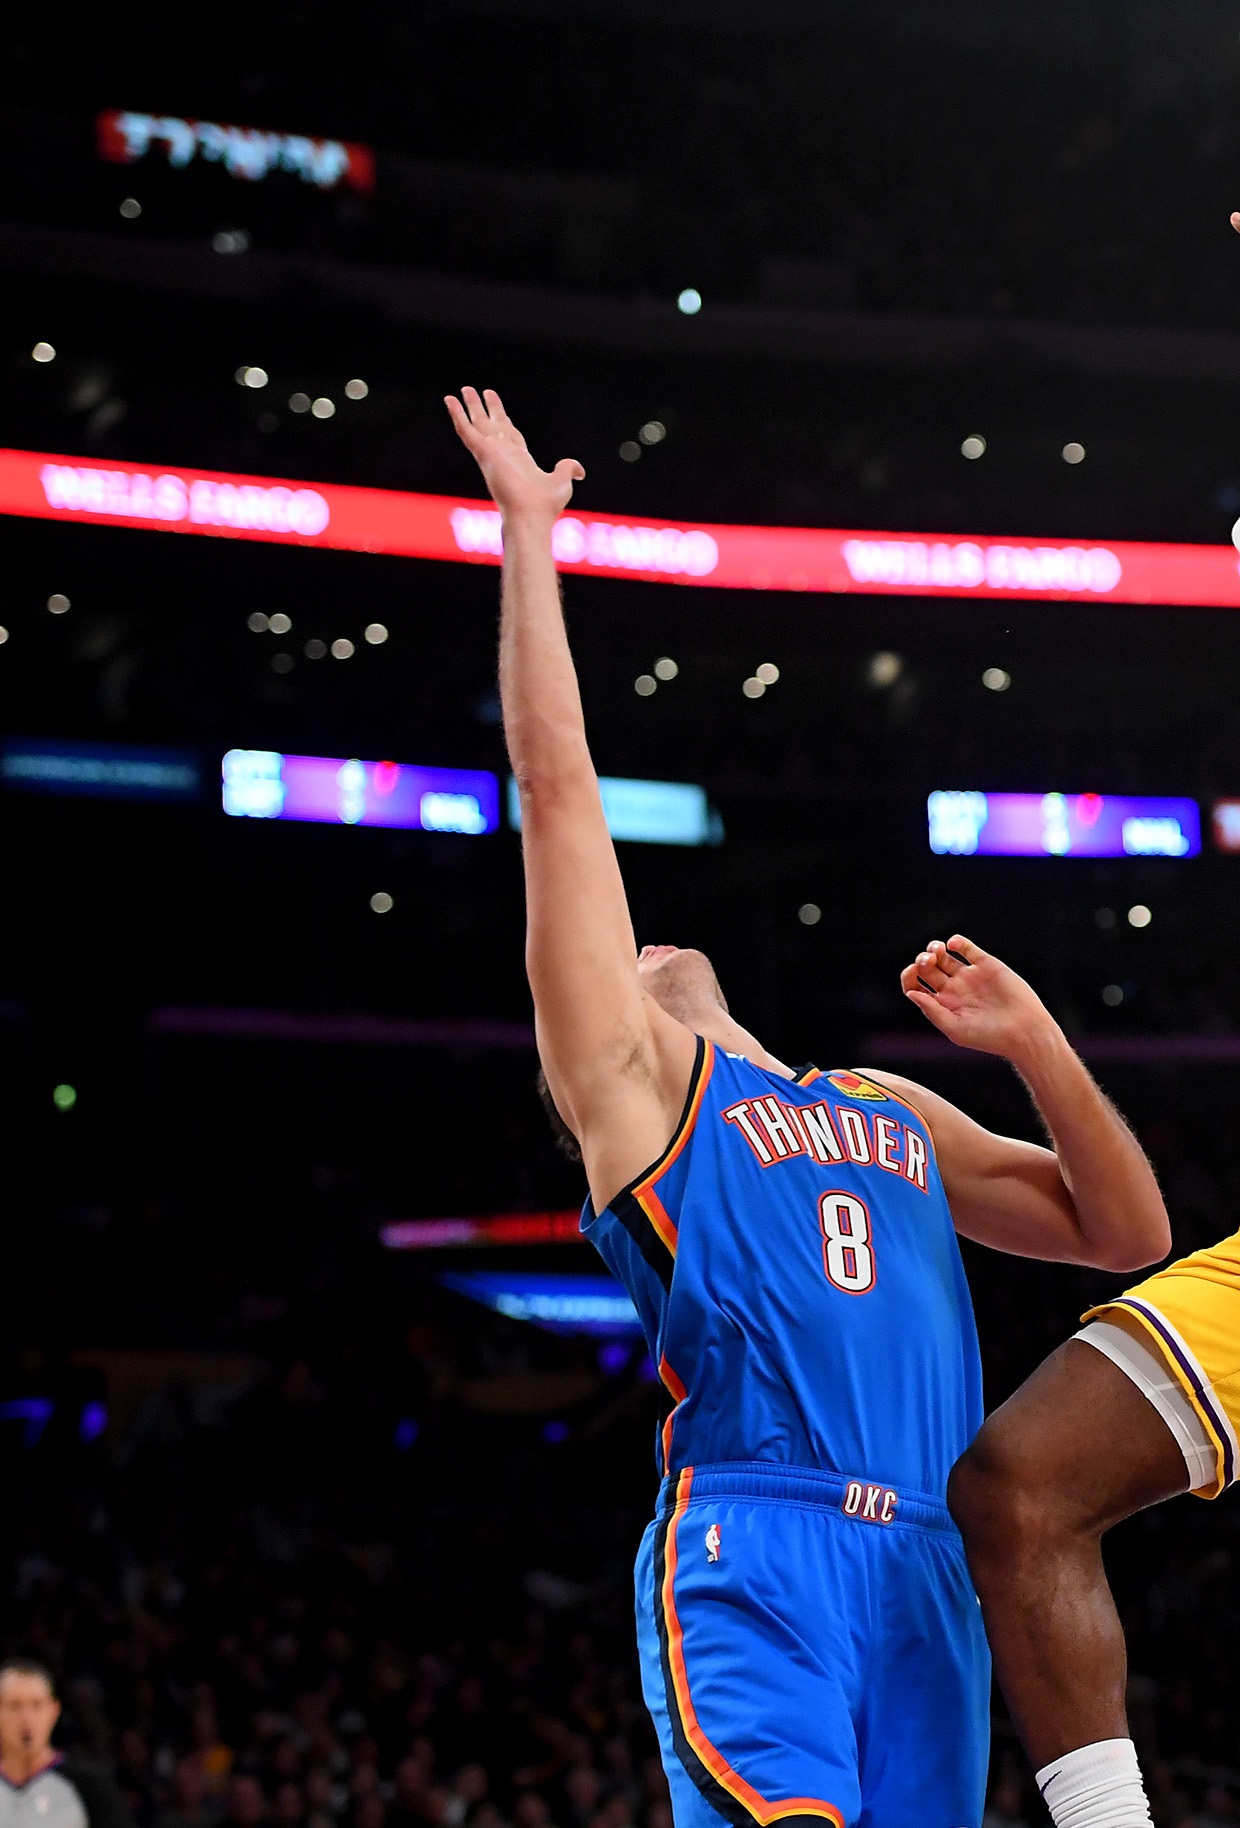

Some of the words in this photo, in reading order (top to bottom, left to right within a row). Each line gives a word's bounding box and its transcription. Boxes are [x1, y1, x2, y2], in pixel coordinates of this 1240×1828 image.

[40, 464, 189, 521] WELLS
[842, 540, 984, 588] WELLS
[817, 1190, 877, 1296] 8
[841, 1480, 898, 1525] OKC
